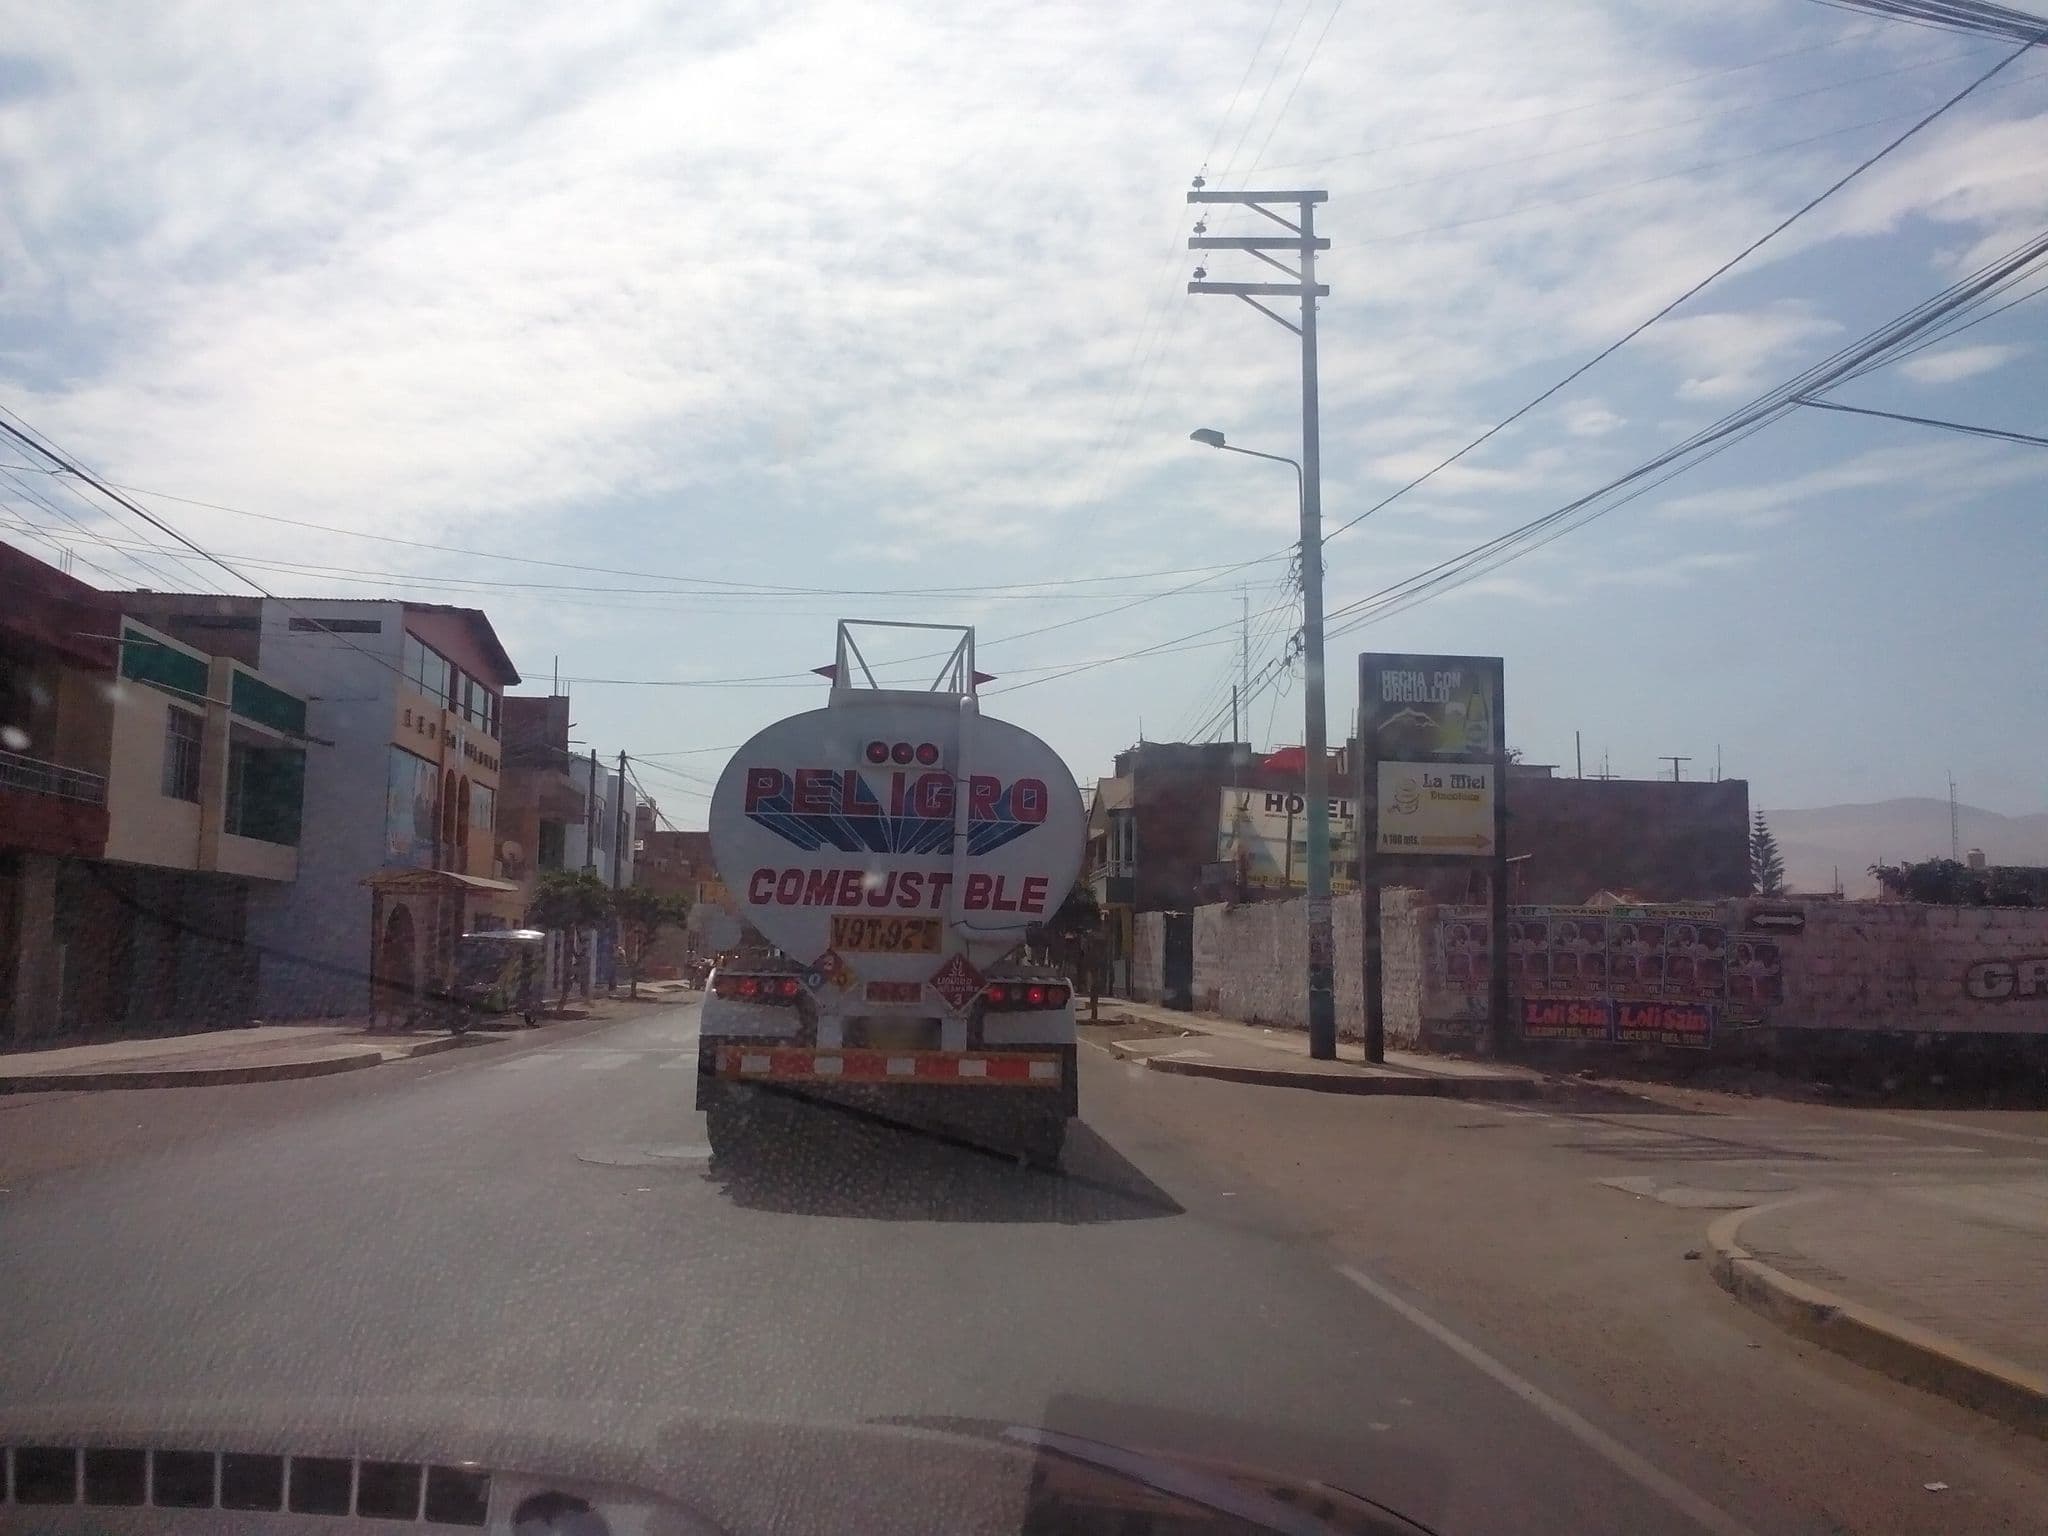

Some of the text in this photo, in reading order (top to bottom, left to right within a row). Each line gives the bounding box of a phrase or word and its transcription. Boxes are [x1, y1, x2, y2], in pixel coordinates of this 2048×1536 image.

[1382, 670, 1461, 688] HECHA CON
[1382, 686, 1450, 703] ORGULLO
[1422, 773, 1485, 790] La Miel
[744, 767, 1049, 825] PELIGRO
[1264, 793, 1354, 819] HOEL
[748, 868, 1049, 913] COMBUSTBLE
